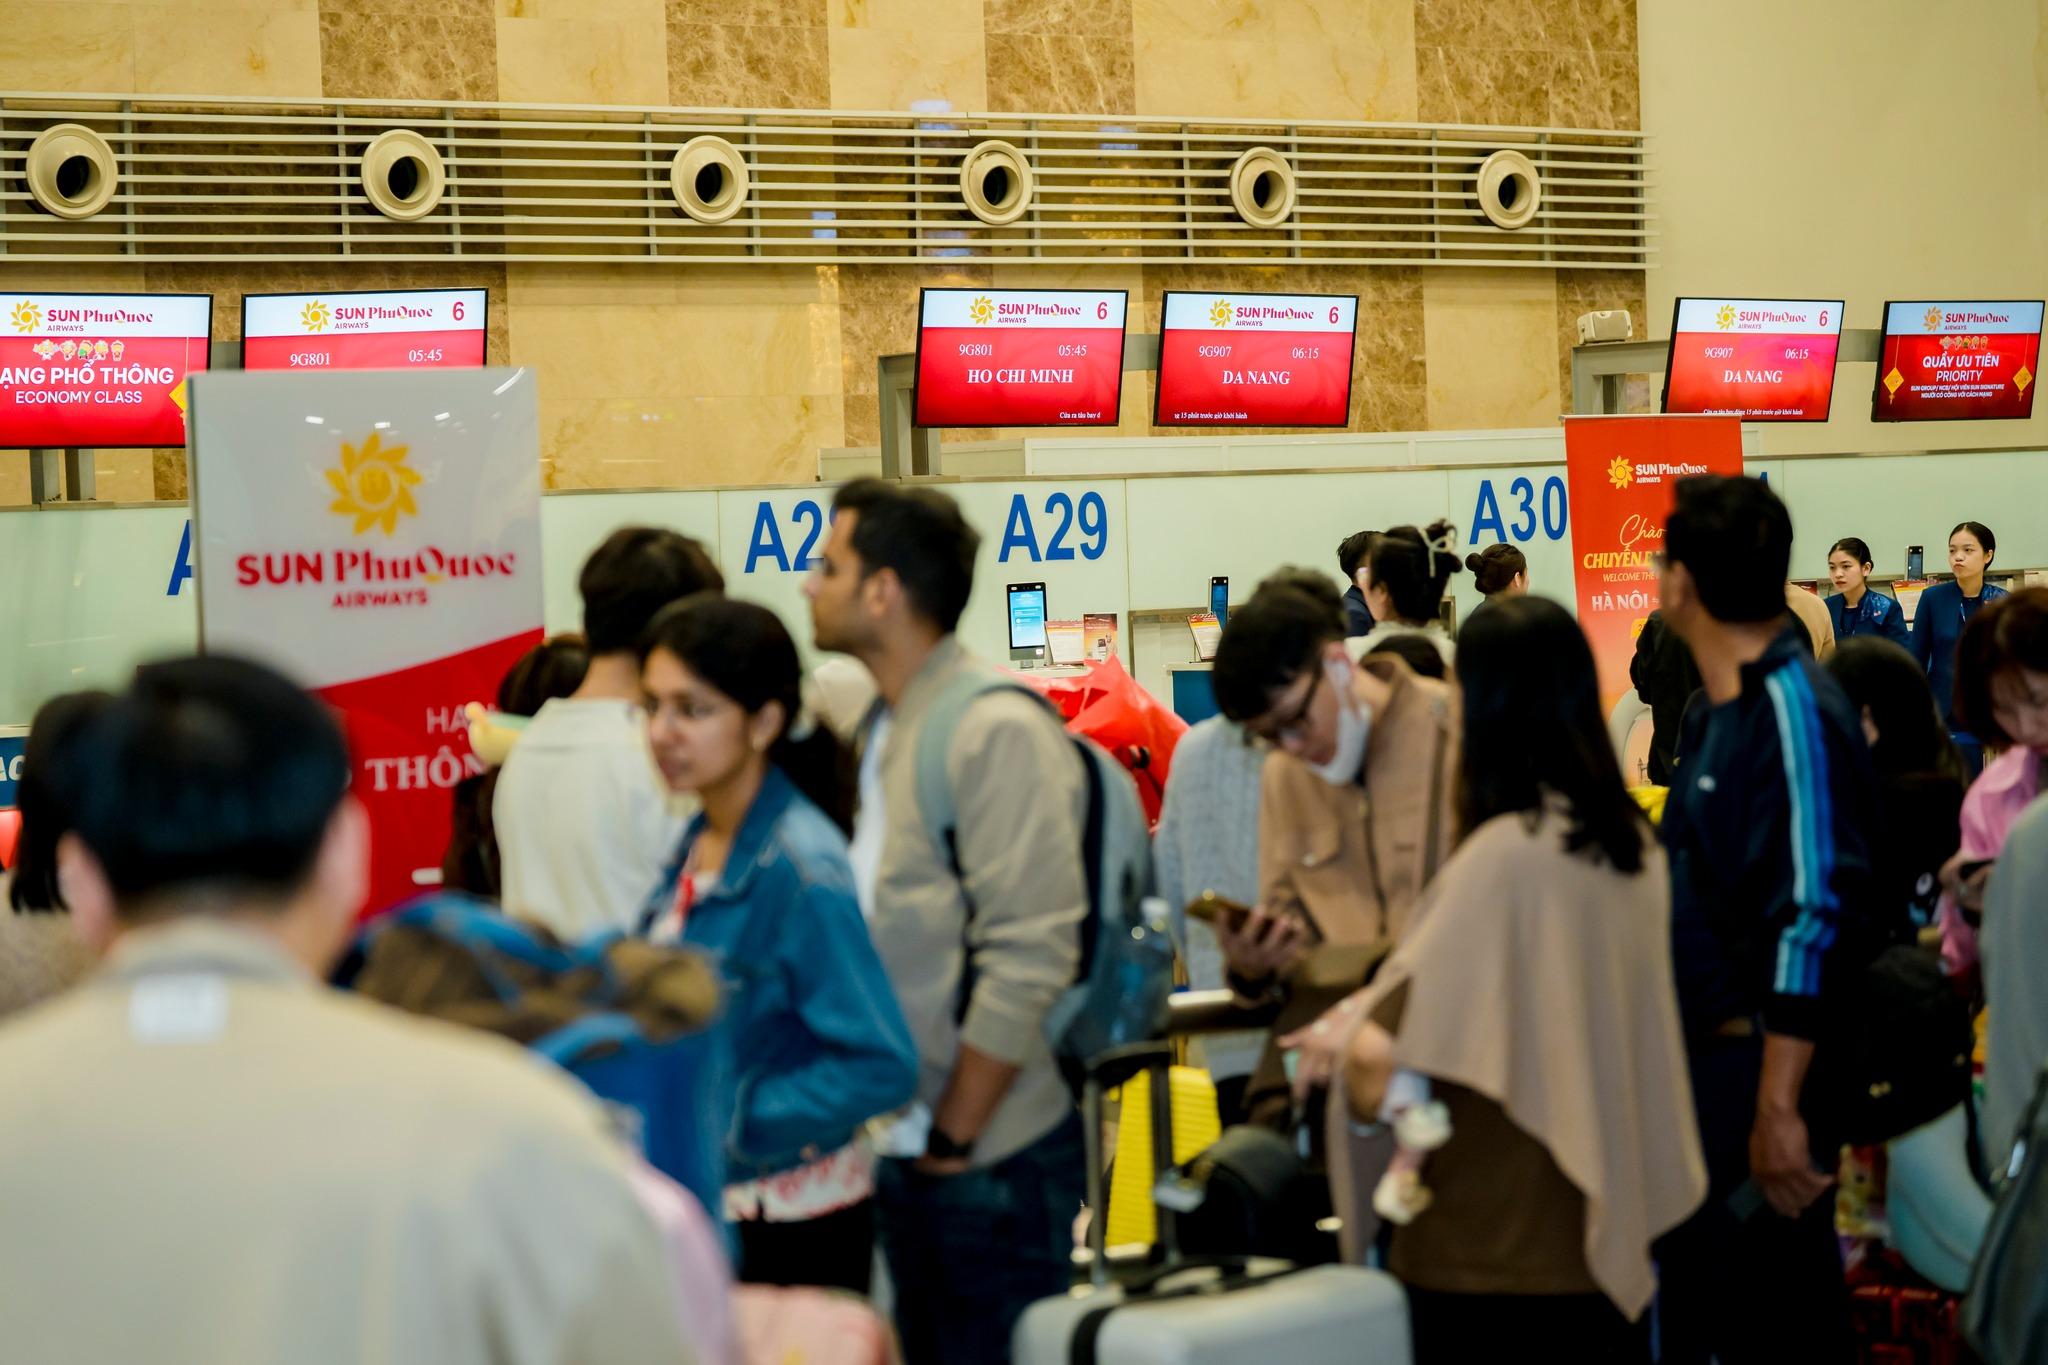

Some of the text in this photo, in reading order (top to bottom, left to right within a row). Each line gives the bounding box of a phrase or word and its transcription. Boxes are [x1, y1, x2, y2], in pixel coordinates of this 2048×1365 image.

[47, 309, 153, 323] SUN PhuQuoc
[335, 305, 433, 320] SUN PhuQuoc
[452, 301, 465, 320] 6
[998, 303, 1081, 316] SUN PhuQuoc
[1097, 301, 1108, 320] 6
[1236, 307, 1315, 320] SUN PhuQuoc
[1328, 306, 1339, 324] 6
[1738, 311, 1807, 323] SUN PhuQuoc
[1819, 310, 1828, 326] 6
[1945, 313, 1966, 323] SUN
[335, 321, 369, 329] AIRWAYS
[408, 349, 443, 362] 05:45
[959, 343, 993, 356] 9G801
[1058, 344, 1087, 356] 05:45
[1199, 346, 1232, 357] 9G907
[1292, 347, 1319, 359] 06:15
[1704, 347, 1734, 359] 9G907
[1785, 348, 1809, 360] 06:15
[290, 352, 331, 367] 9G801
[1956, 354, 1972, 367] ƯU
[1975, 352, 2000, 367] TIÊN
[0, 358, 175, 389] ẠNG PHỔ THÔNG
[967, 369, 1074, 383] HO CHI MINH
[1222, 370, 1291, 385] DA NANG
[1723, 370, 1783, 384] DA NANG
[1936, 370, 1983, 382] PRIORITY
[15, 390, 143, 404] ECONOMY CLASS
[1635, 462, 1708, 475] SUN PhuQuoc
[1636, 476, 1661, 484] AIRWAYS
[1469, 476, 1568, 545] A30
[998, 491, 1108, 563] A29
[744, 500, 837, 573] A2
[236, 552, 323, 587] SUN
[334, 546, 516, 583] PhuQuoc
[1603, 572, 1642, 582] WELCOME
[331, 588, 428, 609] AIRWAYS
[1592, 591, 1614, 611] HÀ
